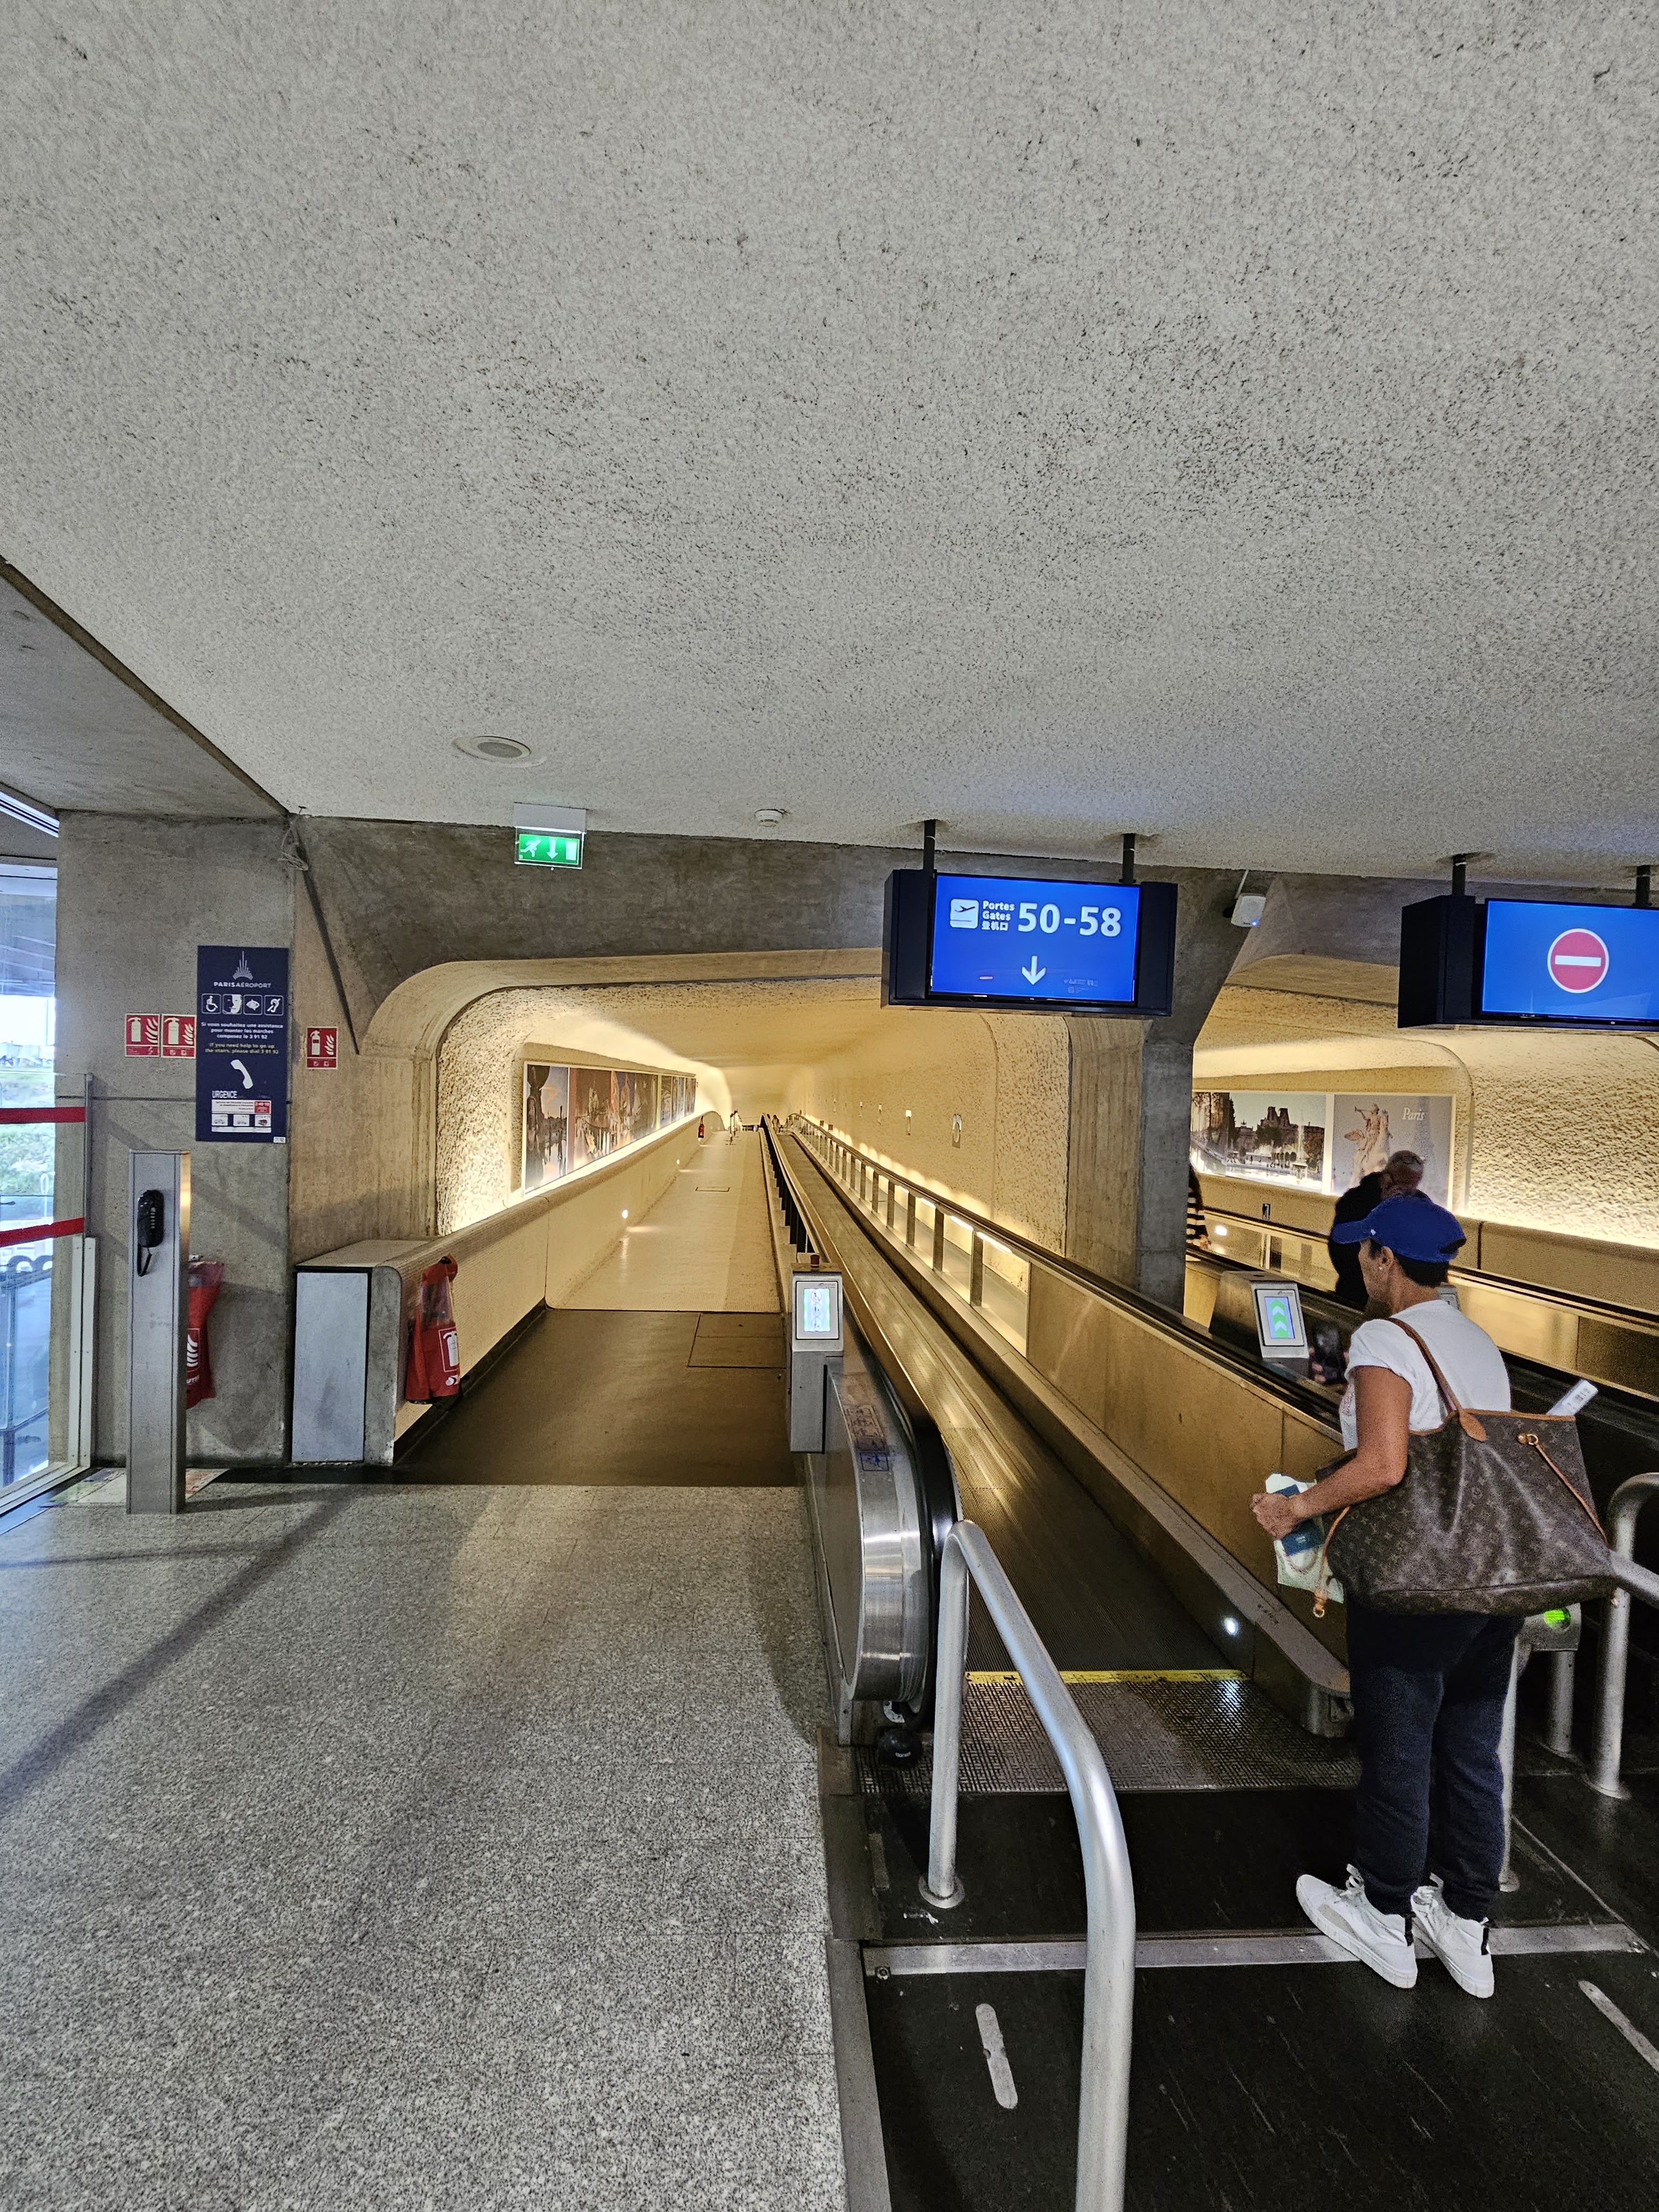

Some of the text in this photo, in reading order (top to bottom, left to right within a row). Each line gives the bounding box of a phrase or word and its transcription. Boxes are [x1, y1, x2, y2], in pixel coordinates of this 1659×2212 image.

[983, 900, 1015, 911] Portes
[982, 911, 1011, 921] Gates
[1018, 902, 1121, 937] 50-58
[982, 921, 1009, 931] 登机口
[212, 1090, 238, 1099] URGENCE
[1401, 1107, 1425, 1121] Paris
